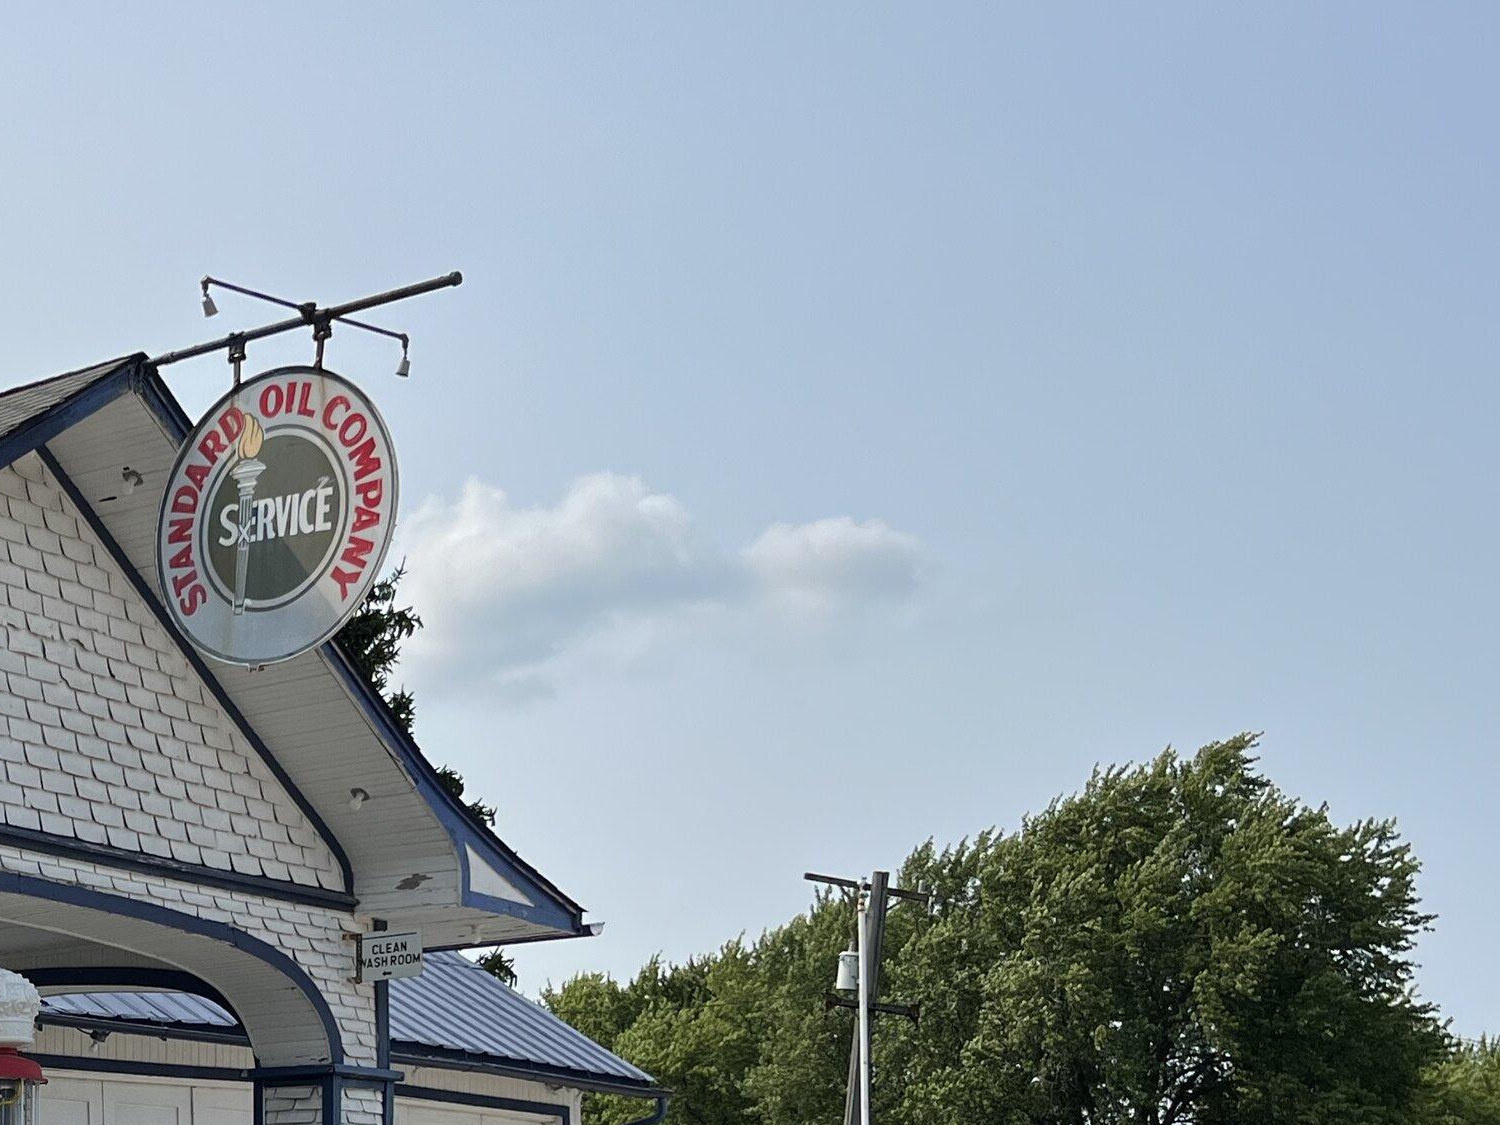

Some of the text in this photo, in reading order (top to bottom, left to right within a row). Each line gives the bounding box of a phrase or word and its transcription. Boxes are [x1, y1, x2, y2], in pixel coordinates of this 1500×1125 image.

[168, 382, 382, 616] STANDARD OIL COMPANY
[218, 486, 334, 546] SERVICE
[372, 941, 407, 955] CLEAN
[390, 953, 420, 965] ROOM
